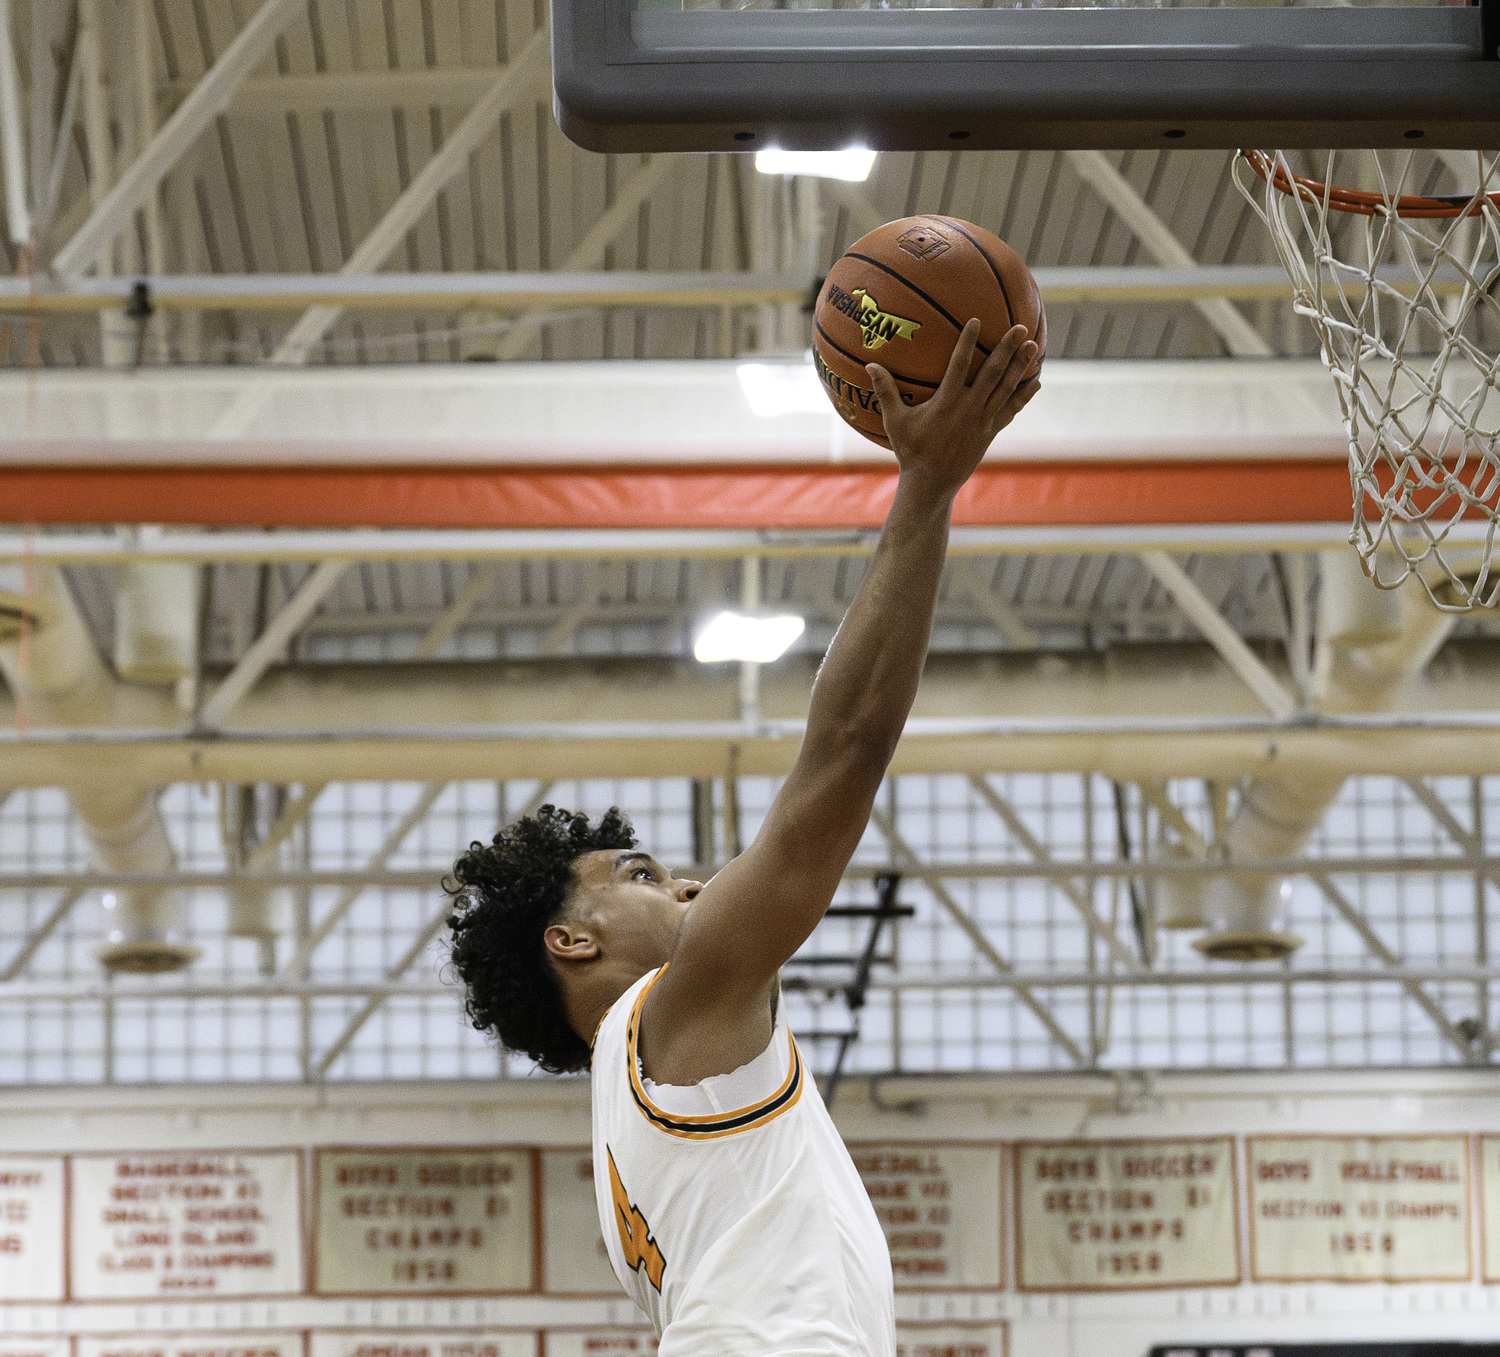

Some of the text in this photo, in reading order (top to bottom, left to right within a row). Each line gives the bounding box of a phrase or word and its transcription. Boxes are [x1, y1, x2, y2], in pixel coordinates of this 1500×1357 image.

[825, 284, 901, 343] NYSPHSAA
[1037, 1155, 1215, 1180] BOYS SOCCER
[1258, 1159, 1459, 1182] BOYS VOLLEYBALL
[342, 1195, 454, 1217] SECTION
[1044, 1189, 1155, 1212] SECTION
[1261, 1199, 1345, 1218] SECTION
[1386, 1200, 1460, 1219] CHAMPS
[1068, 1218, 1185, 1243] CHAMPS
